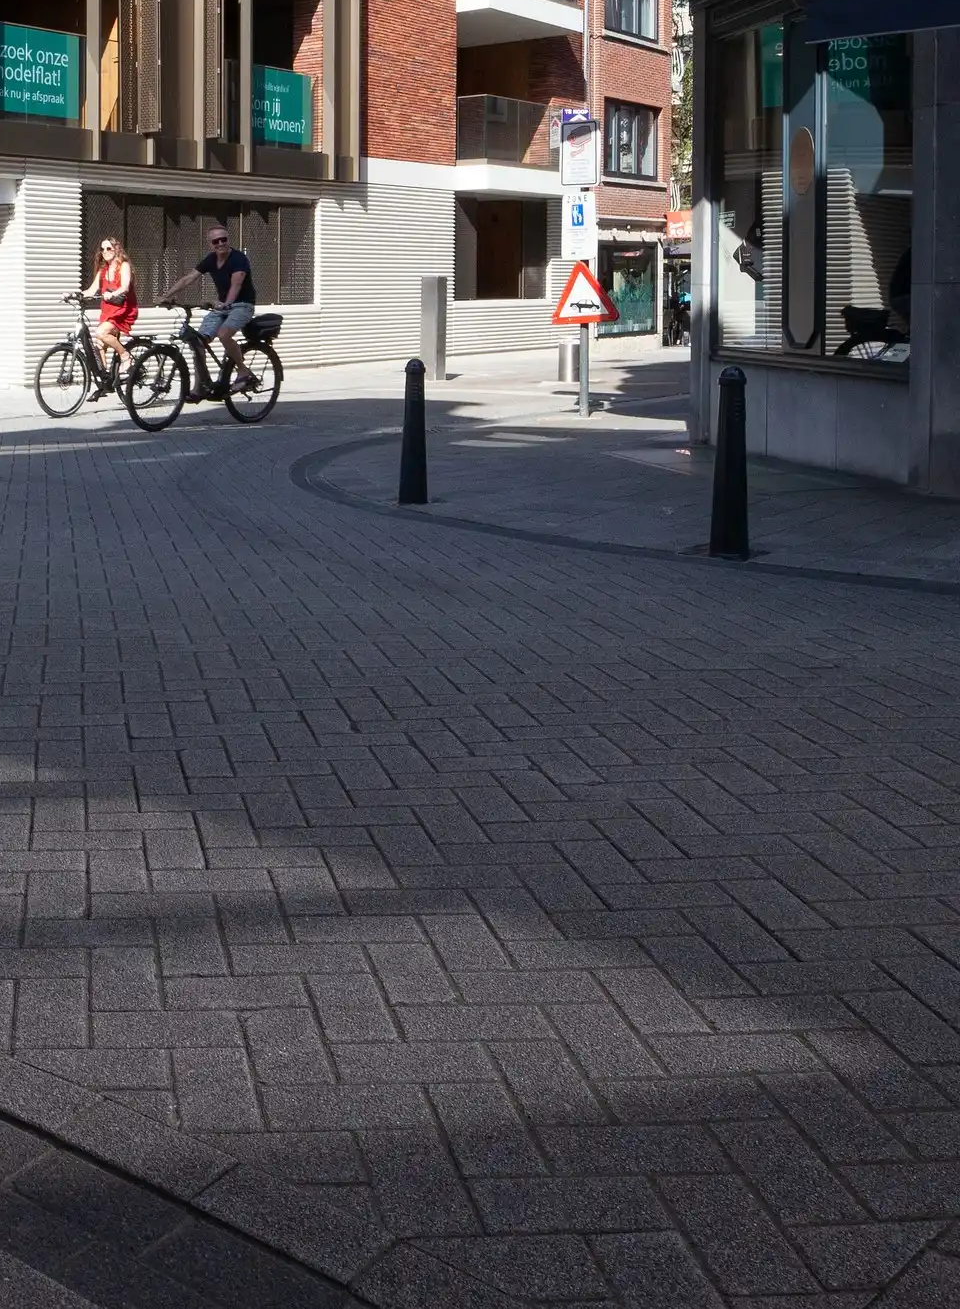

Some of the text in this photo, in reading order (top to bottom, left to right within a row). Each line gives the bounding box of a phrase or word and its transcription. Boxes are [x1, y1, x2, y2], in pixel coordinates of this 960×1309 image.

[36, 50, 69, 67] onze
[10, 89, 21, 99] nu
[22, 89, 30, 102] je
[31, 90, 64, 105] afspraak
[271, 98, 281, 117] jij
[268, 118, 306, 134] wonen?
[566, 194, 588, 204] ZONE
